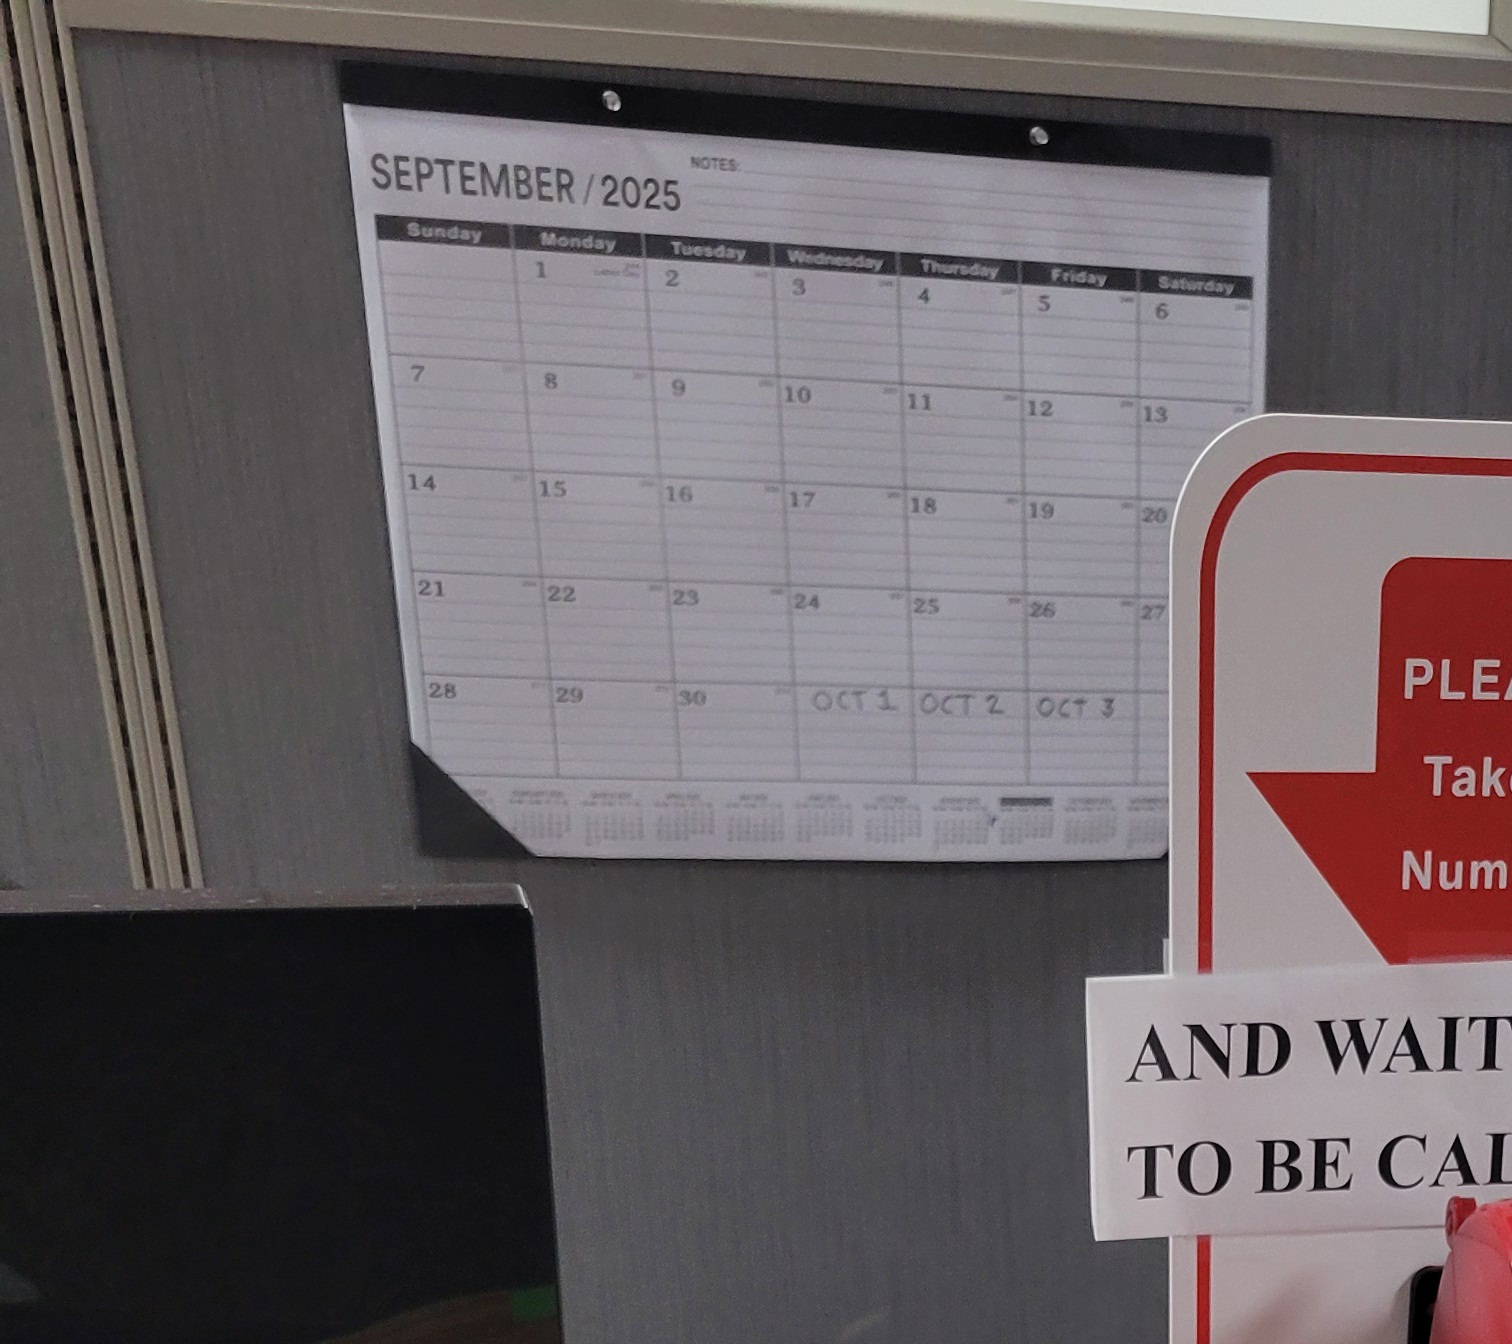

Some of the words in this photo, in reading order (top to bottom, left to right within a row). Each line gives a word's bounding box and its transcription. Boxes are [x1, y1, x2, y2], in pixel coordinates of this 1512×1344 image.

[370, 153, 575, 205] SEPTEMBER
[601, 175, 682, 212] 2025
[406, 221, 482, 244] Sunday
[539, 231, 617, 255] Monday
[670, 241, 747, 263] Tuesday
[787, 248, 885, 273] Wednesday
[920, 258, 1000, 281] Thursday
[1051, 268, 1107, 289] Friday
[1158, 276, 1235, 297] Saturday
[535, 261, 546, 279] 1
[664, 270, 681, 288] 2
[792, 278, 807, 296] 3
[918, 287, 931, 304] 4
[1037, 295, 1051, 312] 5
[1154, 302, 1170, 319] 6
[410, 365, 425, 383] 7
[544, 373, 559, 391] 8
[671, 379, 686, 397] 9
[784, 386, 811, 405] 10
[907, 393, 932, 410] 11
[1028, 399, 1054, 417] 12
[1143, 406, 1169, 423] 13
[408, 473, 437, 492] 14
[540, 480, 567, 498] 15
[665, 485, 693, 503] 16
[789, 491, 816, 509] 17
[911, 497, 937, 514] 18
[1029, 502, 1055, 520] 19
[1143, 507, 1168, 524] 20
[418, 579, 446, 598] 21
[548, 585, 577, 603] 22
[673, 589, 700, 606] 23
[794, 595, 820, 611] 24
[913, 598, 940, 615] 25
[1029, 601, 1056, 619] 26
[1141, 605, 1166, 621] 27
[429, 682, 457, 700] 28
[556, 687, 584, 704] 29
[679, 690, 706, 707] 30
[811, 690, 867, 713] OCT
[877, 690, 898, 712] 1
[920, 692, 976, 716] OCT
[985, 695, 1005, 716] 2
[1036, 696, 1088, 719] OCT
[1100, 697, 1116, 719] 3
[1125, 1021, 1292, 1083] AND
[1127, 1139, 1233, 1201] TO
[1254, 1136, 1353, 1195] BE
